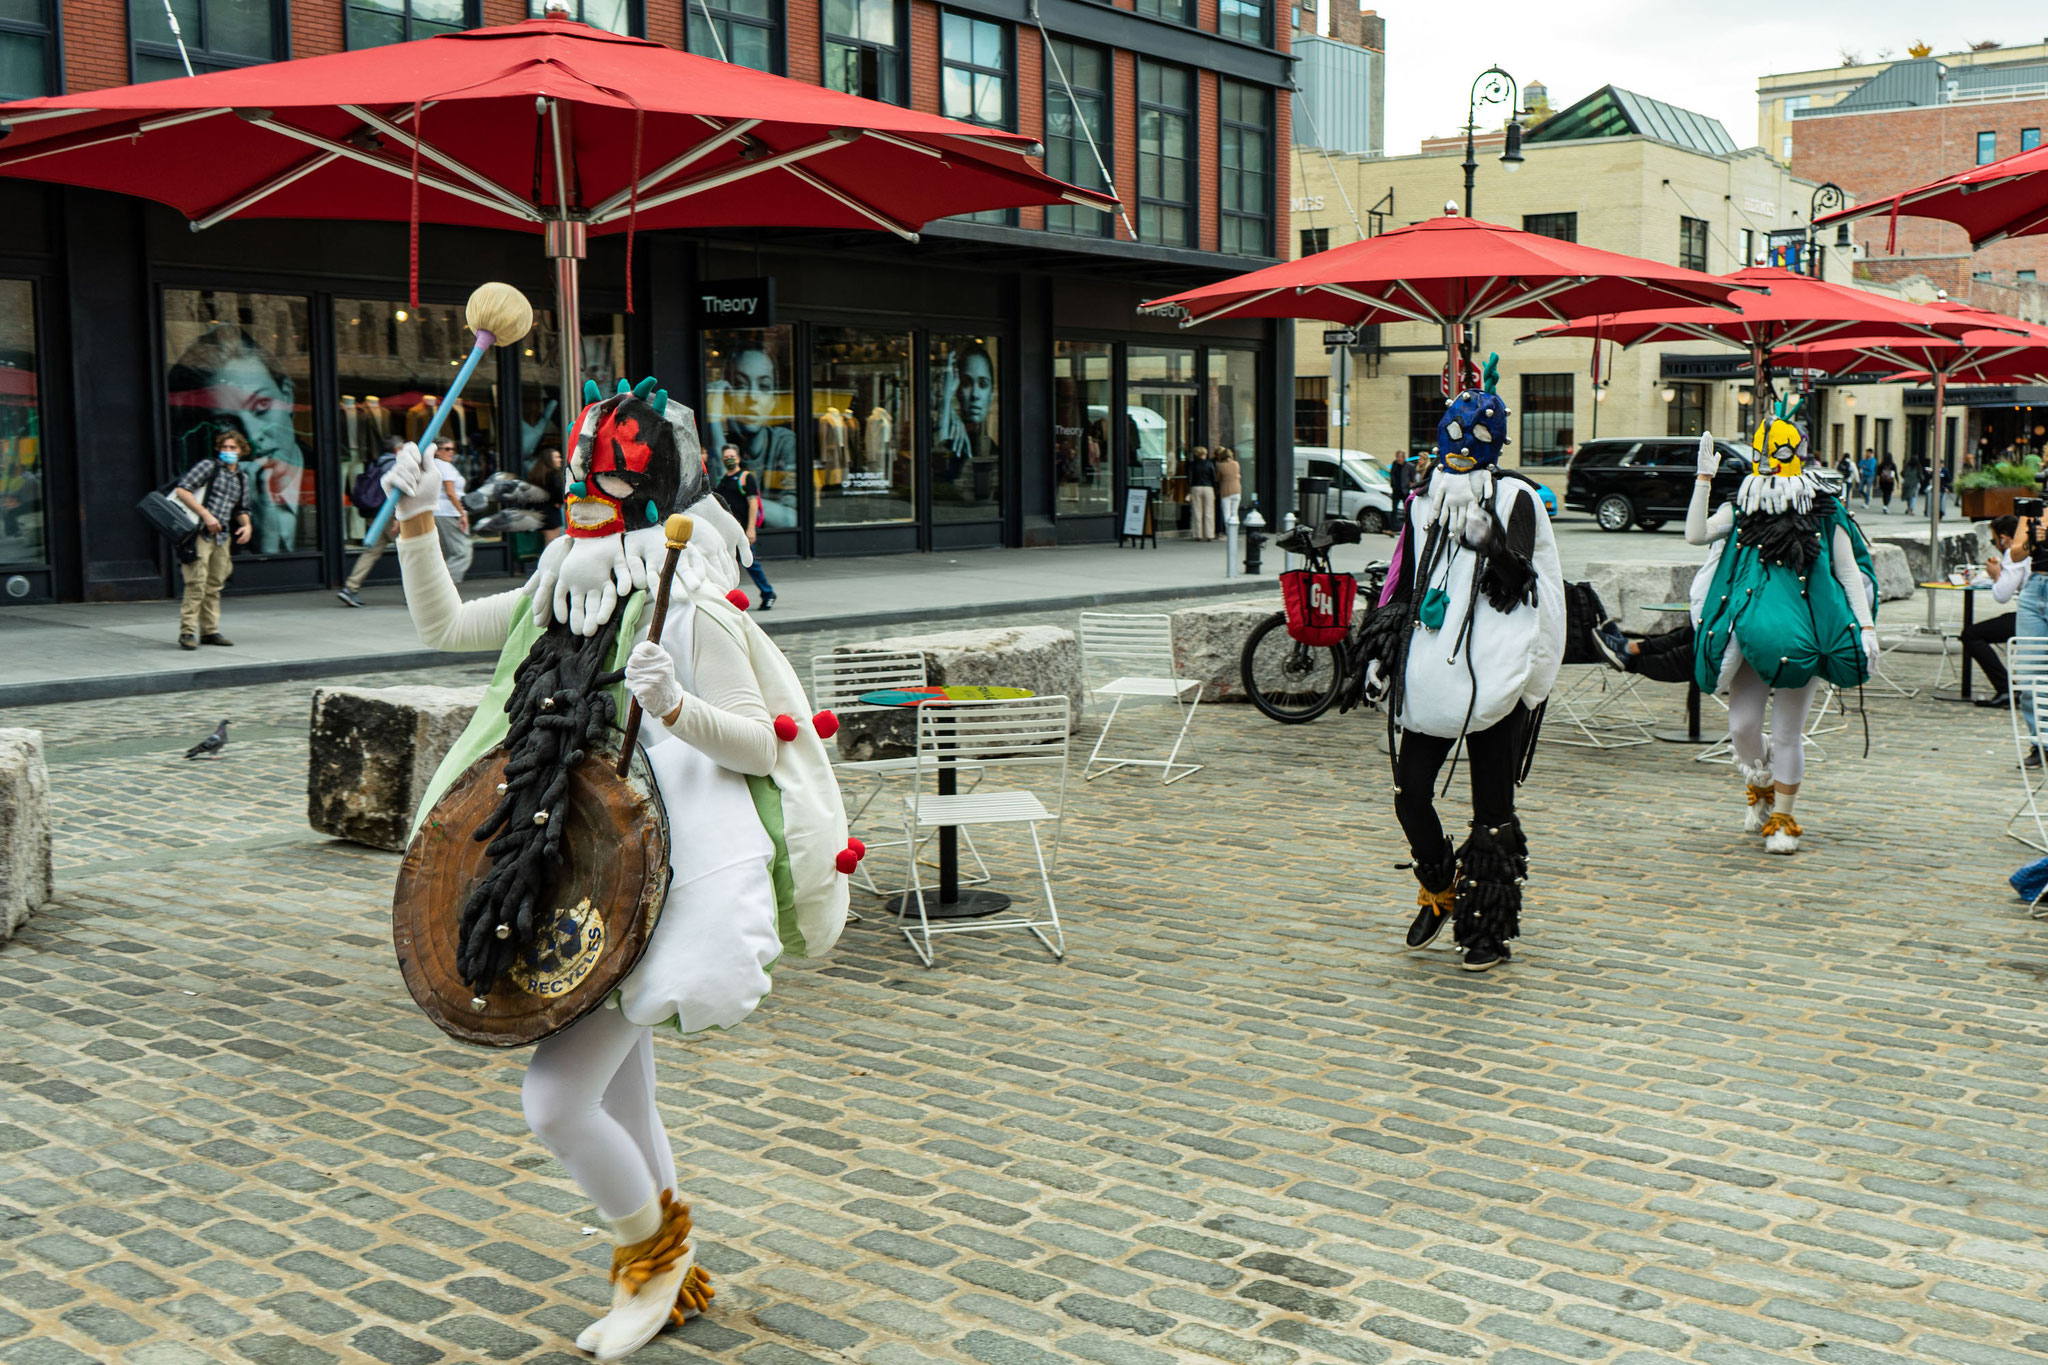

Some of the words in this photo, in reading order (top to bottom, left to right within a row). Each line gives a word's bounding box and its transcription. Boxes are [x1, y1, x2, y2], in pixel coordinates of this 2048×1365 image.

[701, 295, 758, 315] Theory
[1055, 425, 1084, 437] Theory
[1311, 583, 1333, 615] GH
[528, 927, 601, 994] RECYCLES
